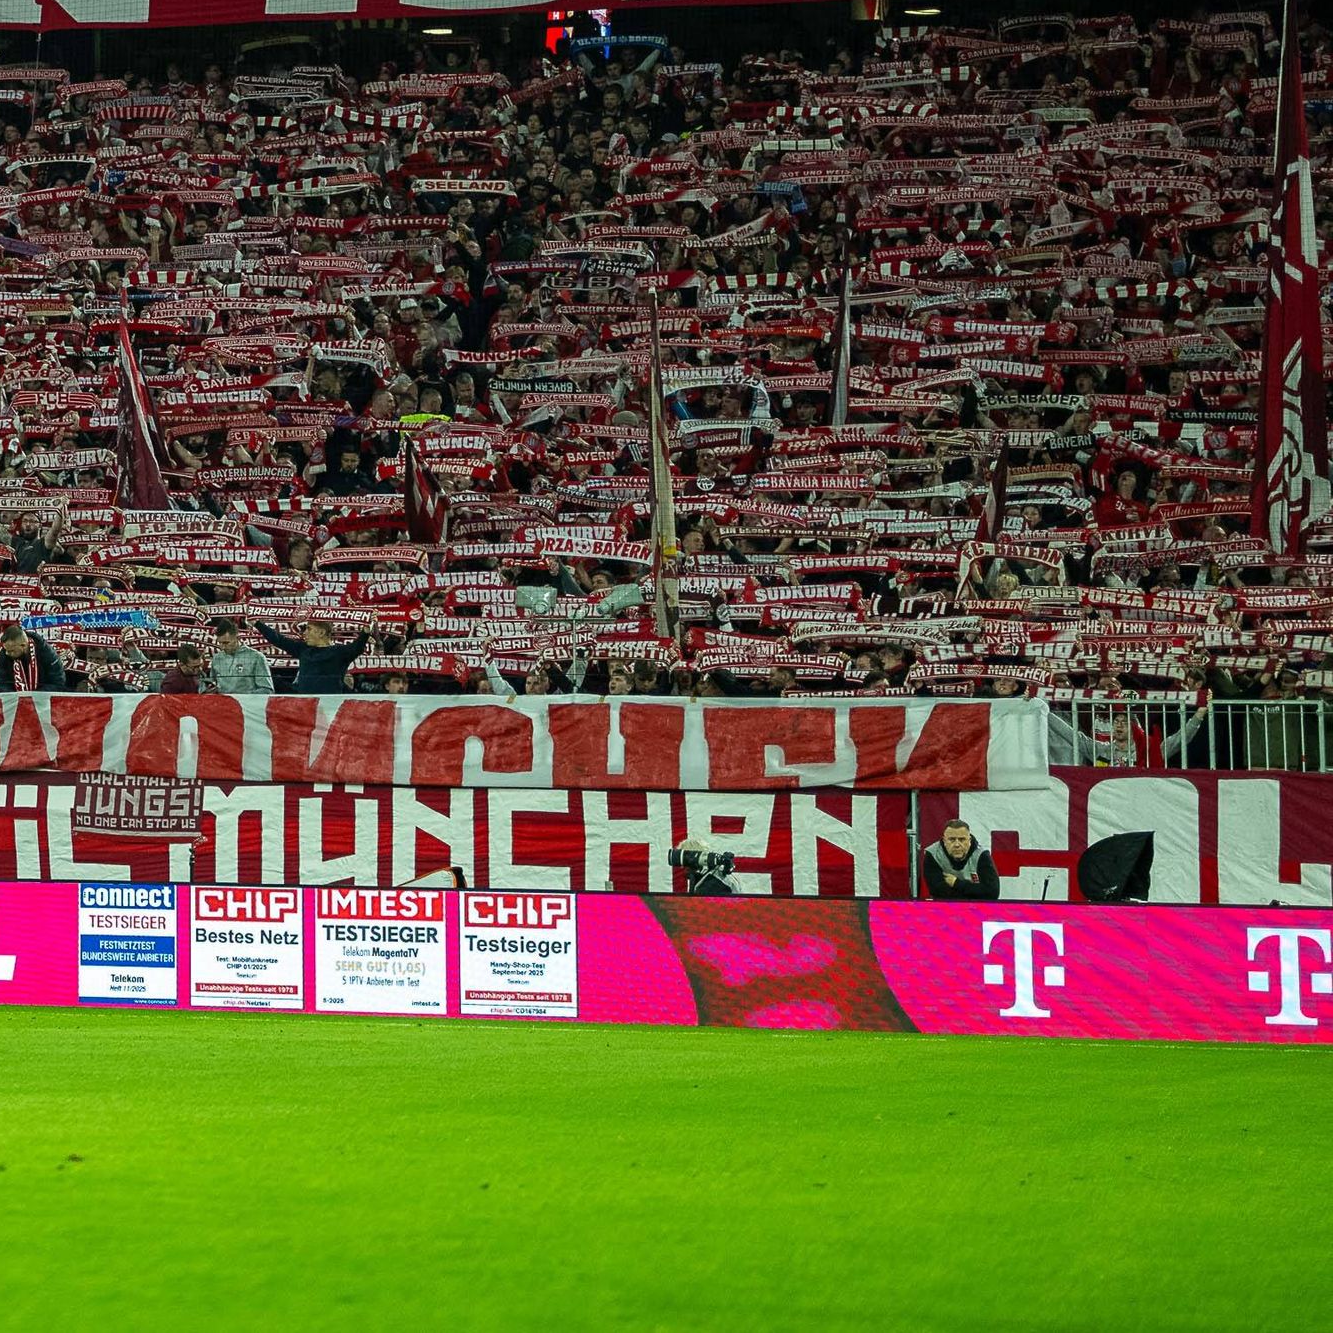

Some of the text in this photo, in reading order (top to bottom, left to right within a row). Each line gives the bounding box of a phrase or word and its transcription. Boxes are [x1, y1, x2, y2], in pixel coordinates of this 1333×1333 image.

[424, 181, 505, 190] SEELAND
[953, 322, 1044, 334] SÜDKURVE
[919, 340, 1004, 356] SÜDKURVE
[961, 359, 1044, 377] SÜDKURVE
[567, 451, 614, 462] BAYERN
[771, 477, 858, 488] BAVARIA HANAU
[525, 526, 614, 541] SÜDKURVE
[593, 543, 650, 559] BAYERN
[789, 556, 888, 569] SÜDKURVE
[755, 584, 852, 601] SÜDKURVE
[248, 608, 370, 621] BAYERN MÜNCHEN
[948, 619, 981, 630] Leben
[774, 653, 845, 666] MÜNCHEN
[987, 666, 1050, 685] MÜNCHEN
[76, 786, 200, 816] JUNGS!
[76, 816, 195, 829] NO ONE CAN STOP US
[83, 886, 171, 908] connect
[322, 890, 439, 917] IMTEST
[199, 889, 295, 919] CHIP
[468, 896, 569, 925] CHIP
[89, 914, 167, 930] TESTSIEGER
[195, 928, 299, 945] Bestes Netz
[322, 925, 439, 943] TESTSIEGER
[99, 940, 156, 951] FESTNETZTEST
[465, 935, 572, 957] Testsieger
[82, 951, 174, 963] BUNDESWEITE ANBIETER
[343, 946, 419, 959] Telekom MagentaTV
[335, 961, 363, 972] SEHR
[366, 961, 389, 972] GUT
[111, 974, 144, 983] Telekom
[407, 977, 420, 986] Test
[199, 984, 243, 994] Unabhängige
[244, 985, 263, 993] Tests
[469, 992, 515, 1001] Unabhängige
